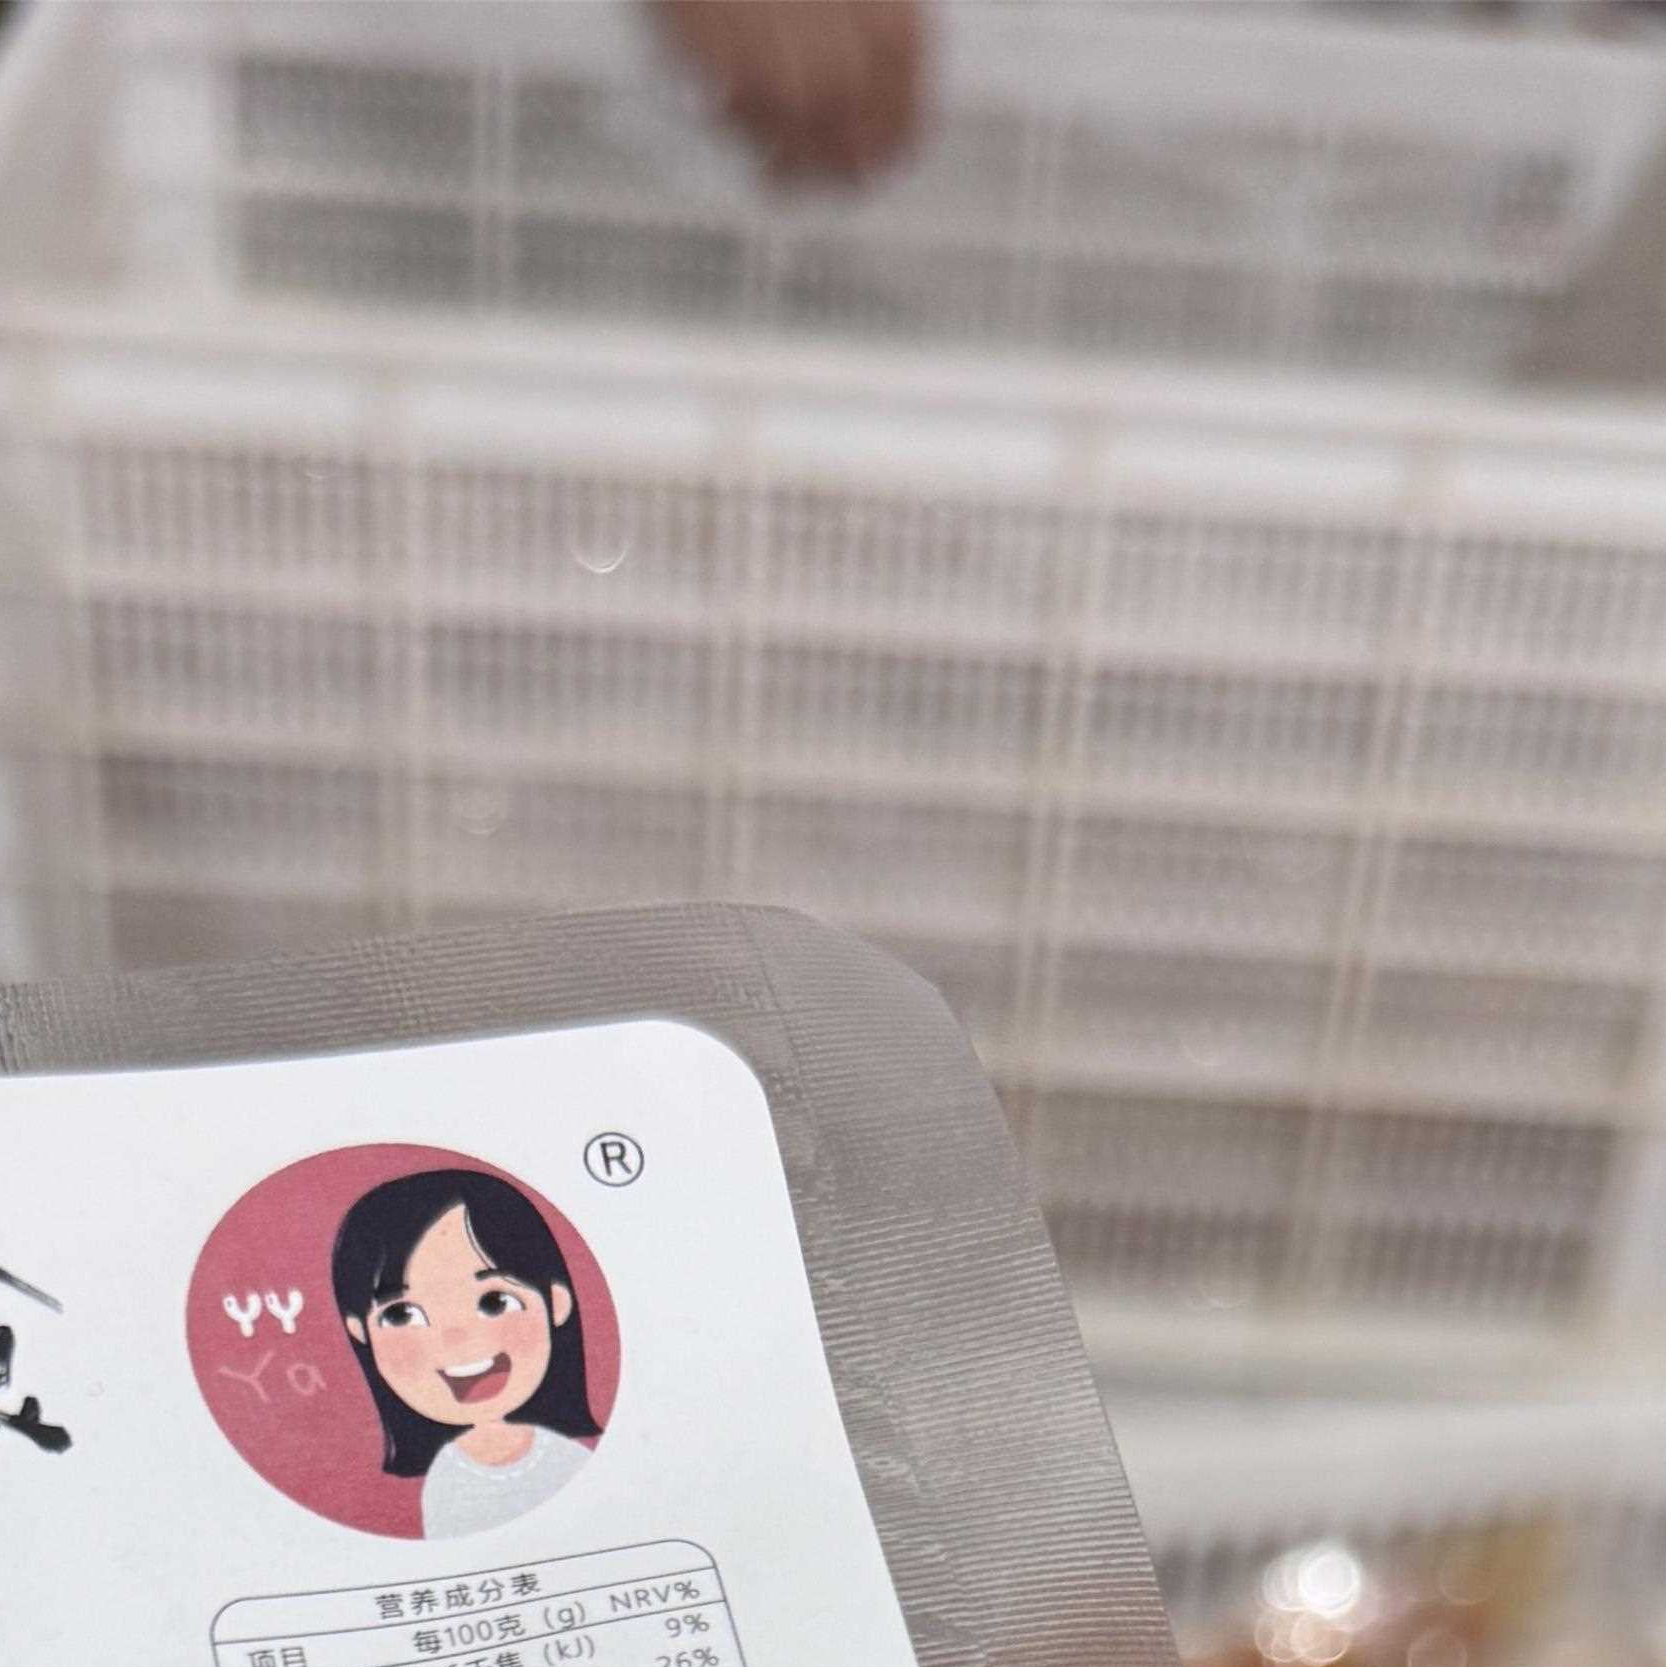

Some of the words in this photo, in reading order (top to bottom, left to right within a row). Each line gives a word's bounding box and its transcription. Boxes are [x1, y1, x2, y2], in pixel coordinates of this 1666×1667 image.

[376, 1572, 542, 1621] 营养成分表
[609, 1580, 701, 1613] NRV%
[665, 1614, 711, 1638] 9%
